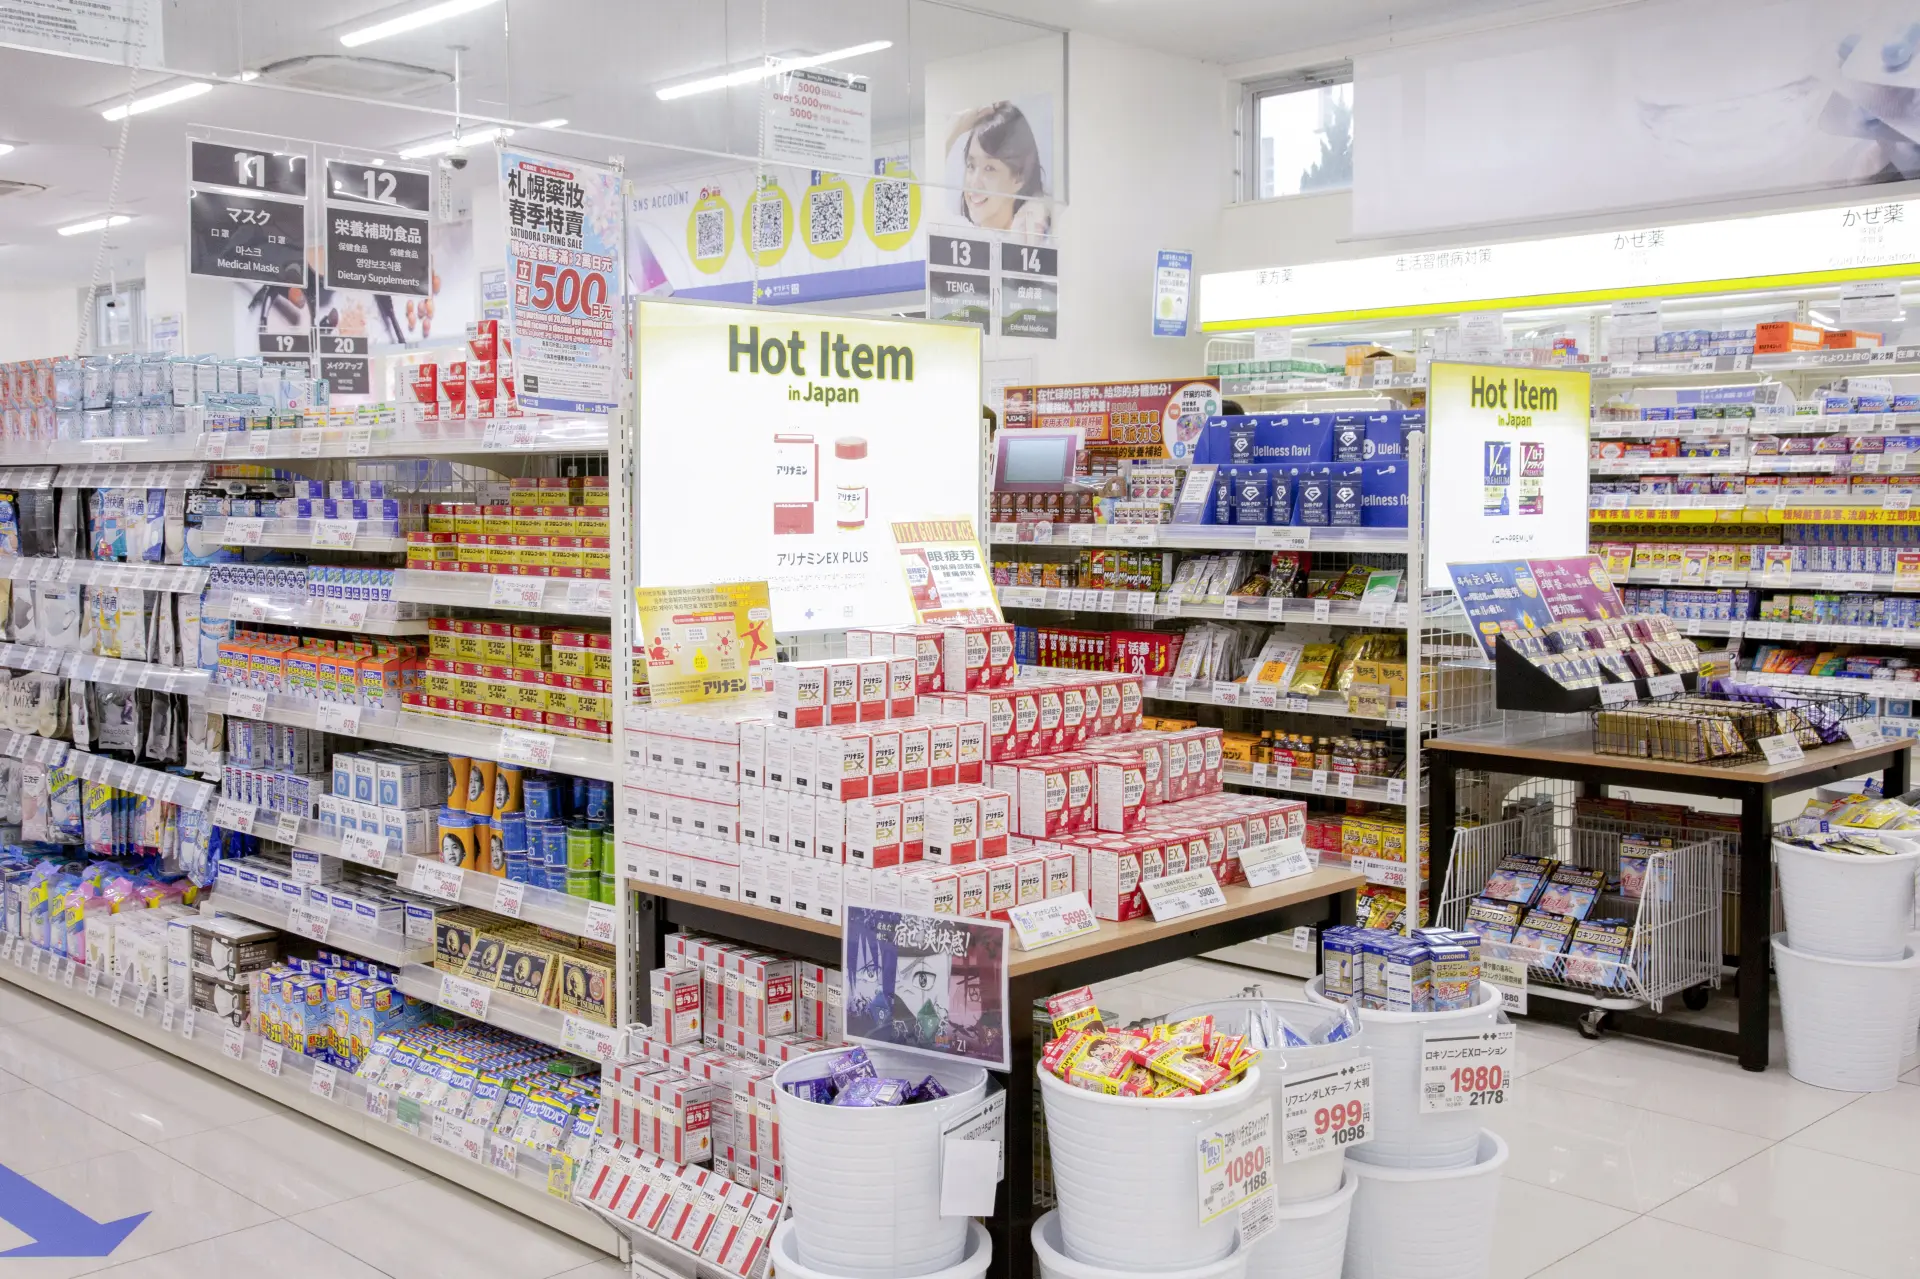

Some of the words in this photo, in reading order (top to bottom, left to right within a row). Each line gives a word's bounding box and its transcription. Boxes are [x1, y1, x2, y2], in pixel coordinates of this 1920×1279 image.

[234, 152, 265, 187] 11
[364, 170, 397, 203] 12
[633, 198, 648, 212] SNS
[652, 192, 689, 208] ACCOUNT
[226, 208, 270, 226] マスク
[509, 199, 584, 238] 春季特賣
[1843, 204, 1904, 227] かぜ薬
[335, 219, 421, 244] 栄養補助食品
[510, 227, 541, 242] SATUDORA
[542, 234, 565, 247] SPRING
[568, 239, 582, 249] SALE
[1614, 230, 1665, 251] かぜ薬
[236, 246, 262, 256] 마스크
[950, 240, 971, 266] 13
[218, 258, 251, 270] Medical
[253, 262, 280, 273] Masks
[1021, 248, 1041, 272] 14
[1395, 248, 1492, 272] 生活習慣病対策
[338, 270, 366, 283] Dietary
[368, 274, 420, 287] Supplements
[1256, 268, 1293, 285] 漢方薬
[531, 264, 606, 316] 500
[946, 281, 975, 293] TENGA
[591, 304, 612, 318] 日元
[1010, 324, 1028, 332] External
[276, 336, 294, 351] 19
[334, 338, 354, 353] 20
[728, 324, 806, 376] Hot
[820, 331, 914, 381] Item
[1871, 352, 1894, 361] 第2類
[788, 385, 800, 401] in
[803, 382, 859, 406] Japan
[1471, 376, 1507, 409] Hot
[1514, 378, 1558, 410] Item
[1498, 416, 1505, 426] in
[1506, 413, 1532, 429] Japan
[1291, 445, 1310, 456] Navi
[776, 466, 807, 476] アリナミン
[1484, 476, 1510, 485] PREMIUM
[837, 493, 861, 502] アリナミン
[776, 552, 839, 566] アリナミンEX
[842, 552, 868, 564] PLUS
[967, 635, 979, 646] EX
[558, 652, 578, 660] パブロン
[703, 680, 746, 695] アリナミン
[834, 687, 852, 697] EX
[863, 685, 881, 695] EX
[992, 702, 1005, 713] EX
[875, 757, 895, 768] EX
[905, 753, 923, 764] EX
[954, 825, 972, 836] EX
[1384, 872, 1404, 881] 2380
[1553, 873, 1599, 886] ロキソプロフェン
[1199, 887, 1214, 897] 3980
[963, 897, 982, 909] EX
[1063, 910, 1086, 925] 5699
[1470, 908, 1514, 922] ロキソプロフェン
[1078, 921, 1092, 930] 6268
[1525, 917, 1568, 932] ロキソプロフェン
[1576, 930, 1623, 944] ロキソプロフェン
[375, 994, 392, 1007] No.1
[471, 1000, 483, 1009] 699
[597, 1041, 612, 1055] 699
[1425, 1047, 1507, 1060] ロキソニンEXローション
[1450, 1065, 1502, 1092] 1980
[1502, 1079, 1510, 1088] 円
[1286, 1082, 1350, 1106] リフェンダLXテープ
[1354, 1076, 1370, 1090] 大判
[1469, 1090, 1504, 1106] 2178
[1315, 1100, 1362, 1135] 999
[1363, 1112, 1370, 1121] 円
[1332, 1125, 1365, 1146] 1098
[464, 1139, 478, 1150] 480
[1225, 1146, 1265, 1187] 1080
[1265, 1154, 1271, 1166] 円
[1242, 1171, 1267, 1195] 1188
